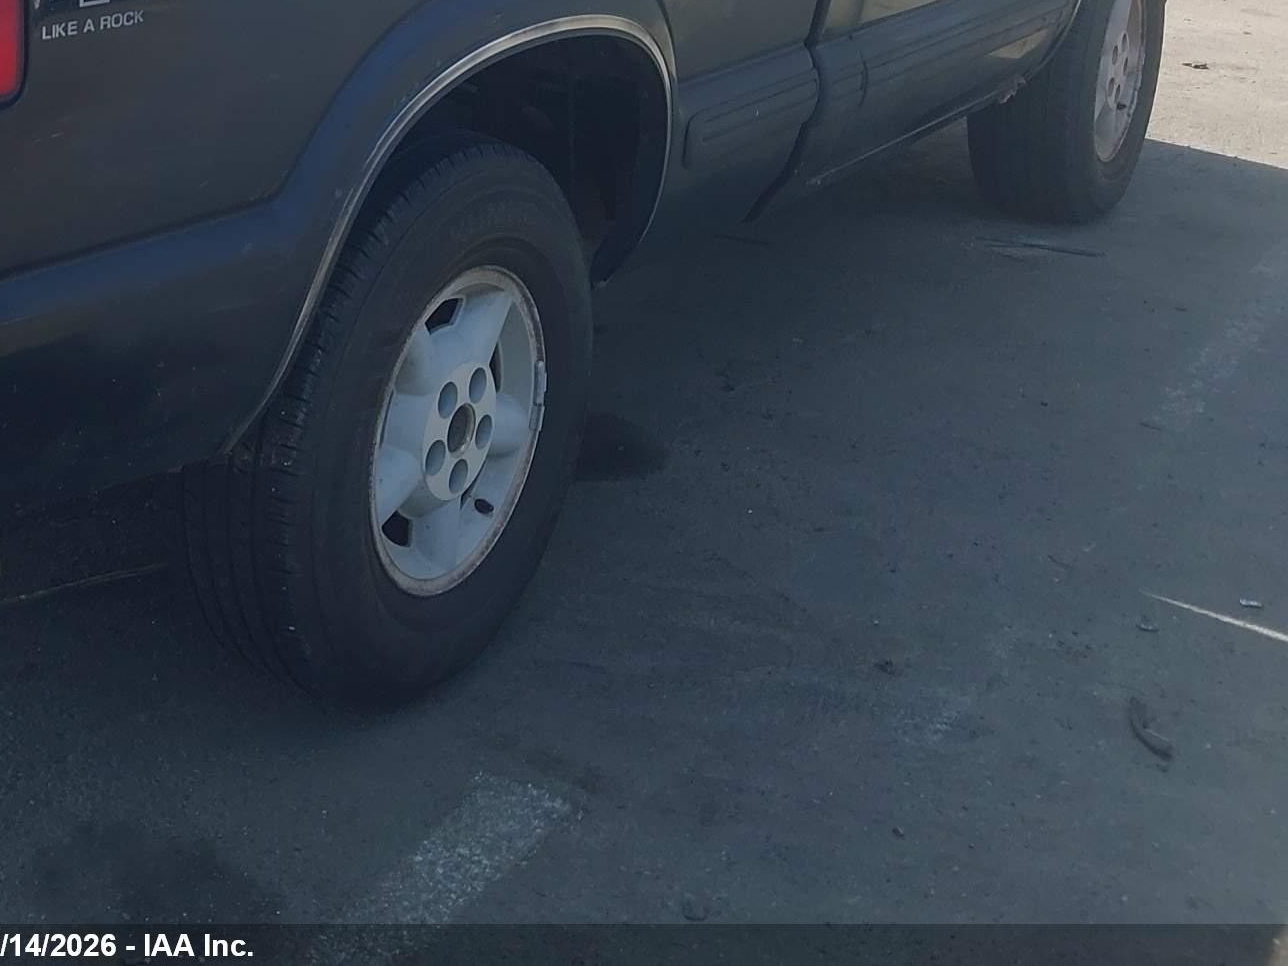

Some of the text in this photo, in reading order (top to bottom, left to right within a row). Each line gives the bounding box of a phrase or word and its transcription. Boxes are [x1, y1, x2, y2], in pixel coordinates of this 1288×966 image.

[42, 10, 144, 40] LIKE A ROCK
